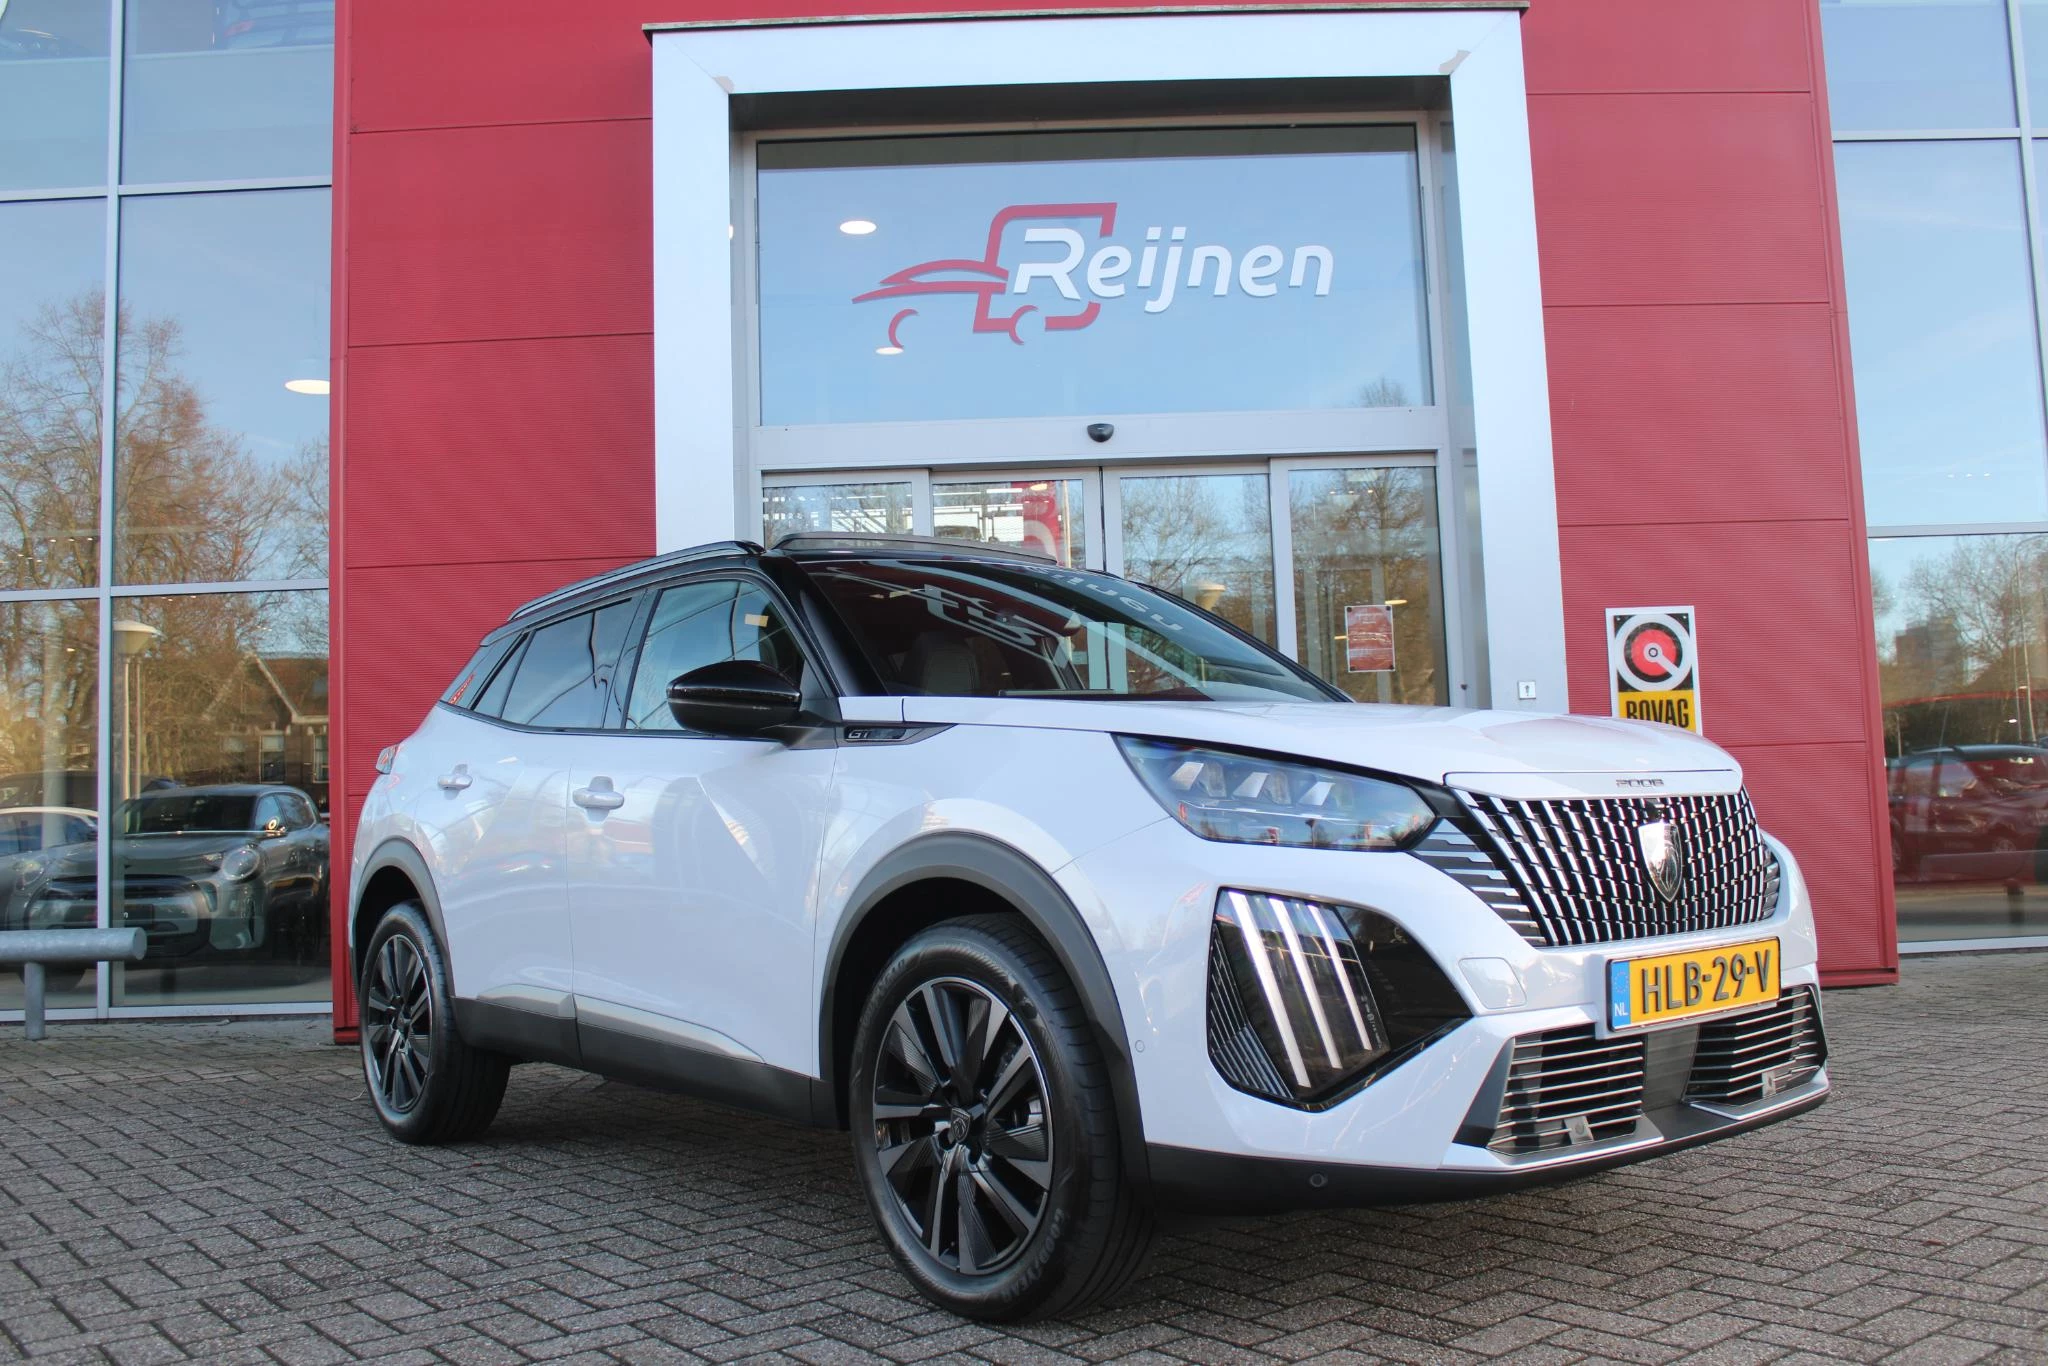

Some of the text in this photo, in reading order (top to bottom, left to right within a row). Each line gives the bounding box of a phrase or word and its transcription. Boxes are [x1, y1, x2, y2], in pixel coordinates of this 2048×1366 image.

[1013, 227, 1334, 313] Reijnen
[1614, 1002, 1628, 1016] NL
[1641, 949, 1771, 1014] HLB-29-V
